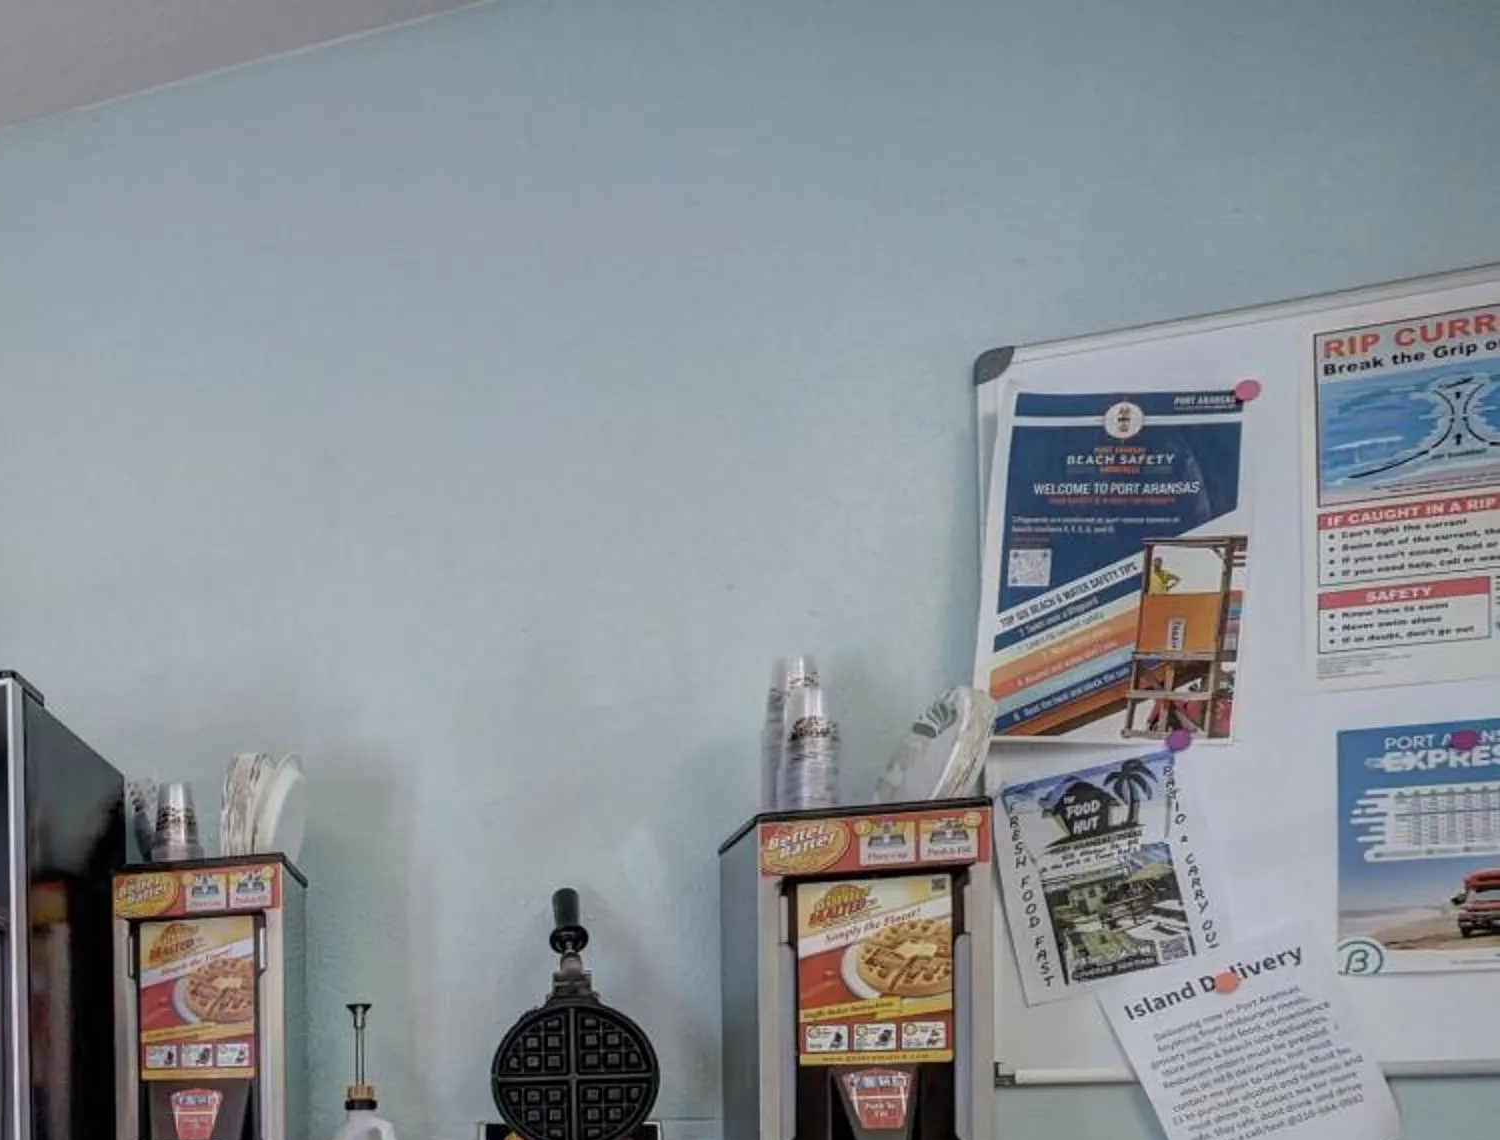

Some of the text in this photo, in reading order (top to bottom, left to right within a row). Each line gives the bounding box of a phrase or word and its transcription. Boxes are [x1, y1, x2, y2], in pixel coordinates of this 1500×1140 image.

[1323, 332, 1381, 359] RIP
[1323, 339, 1500, 376] Break the Grip o
[1067, 454, 1176, 465] BEACH SAFETY
[1033, 481, 1201, 495] WELCOME TO PORT ARANSAS
[1328, 497, 1497, 527] IF CAUGHT IN A RIP
[1365, 586, 1433, 602] SAFETY
[1384, 729, 1500, 750] PORT ANS
[1066, 800, 1101, 818] FOOD
[1072, 816, 1100, 835] HUT
[1123, 982, 1197, 1020] Island
[1200, 946, 1303, 993] Dlivery
